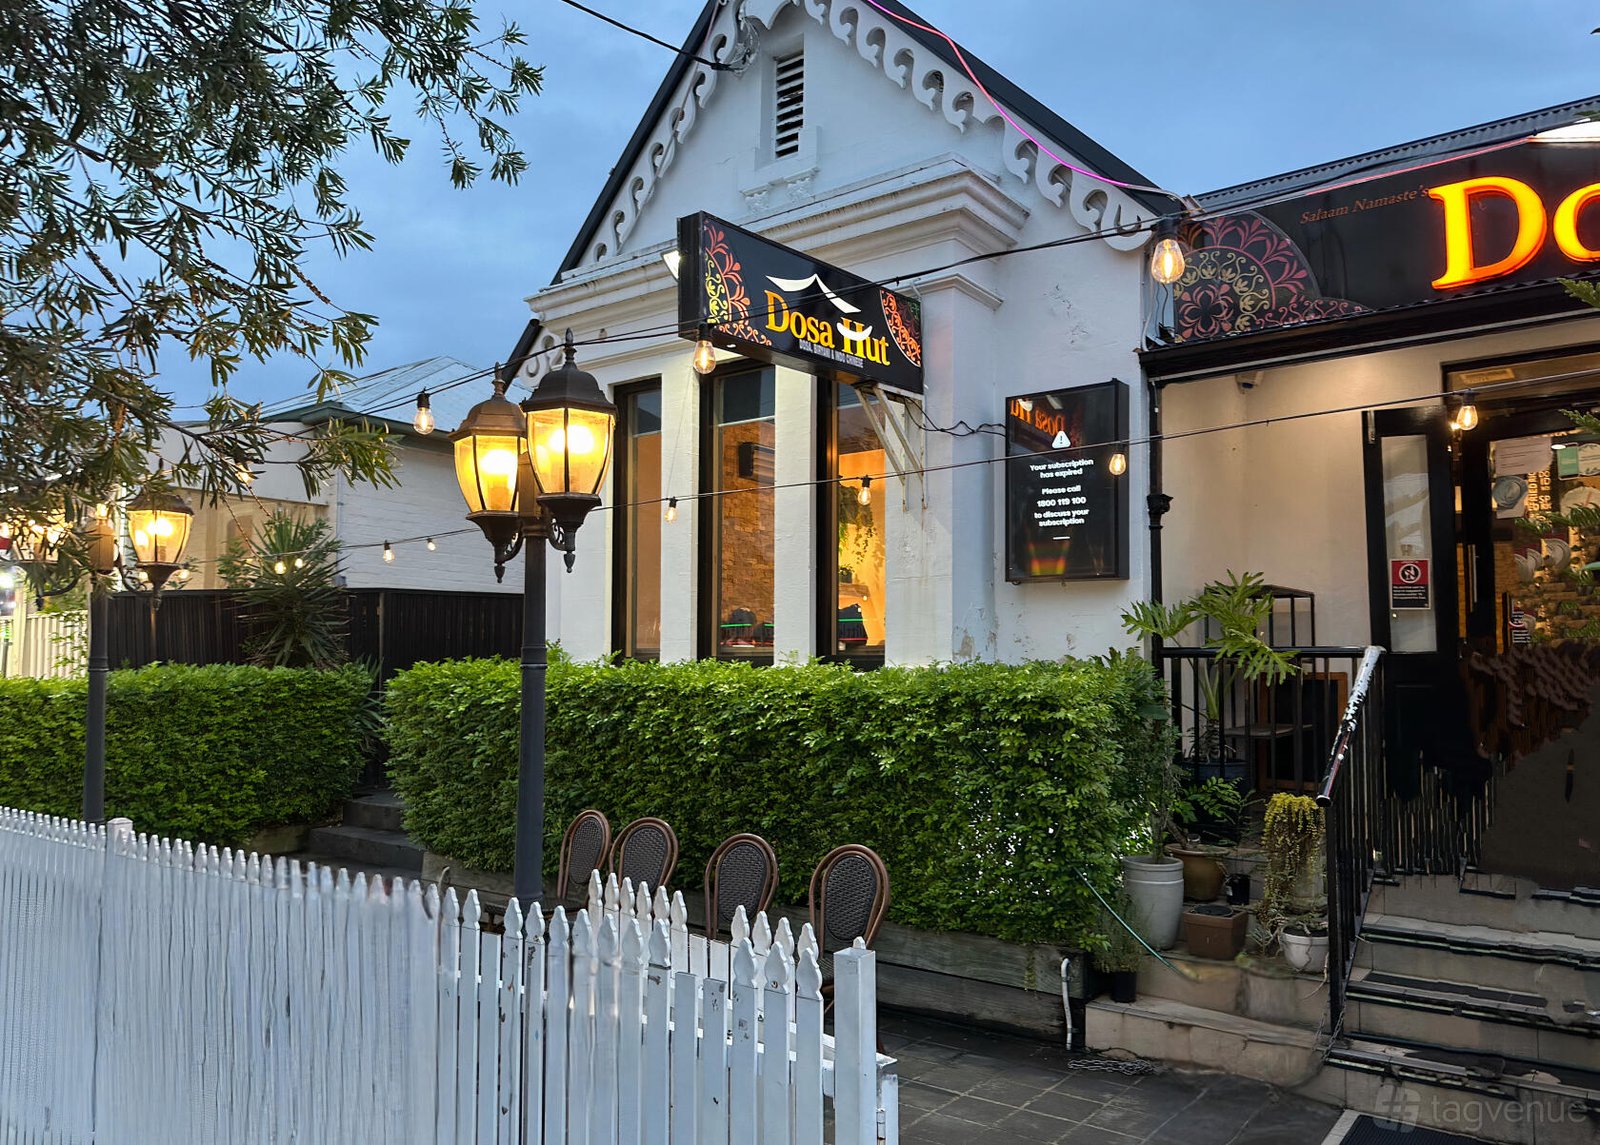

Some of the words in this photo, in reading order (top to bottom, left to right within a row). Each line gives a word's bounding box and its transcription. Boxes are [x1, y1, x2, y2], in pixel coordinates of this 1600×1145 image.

[1300, 208, 1349, 224] Salaam
[1352, 184, 1428, 213] Namaste's
[1428, 176, 1600, 290] Do
[764, 289, 836, 349] Dosa
[840, 316, 891, 366] Hut
[1048, 458, 1094, 469] subscription
[1055, 468, 1083, 478] expired
[1041, 487, 1066, 495] Please
[1067, 484, 1081, 492] call
[1037, 499, 1056, 507] 1800
[1057, 498, 1071, 506] 119
[1071, 496, 1087, 505] 100
[1043, 510, 1071, 518] discuss
[1071, 509, 1090, 518] your
[1038, 518, 1085, 527] subscription
